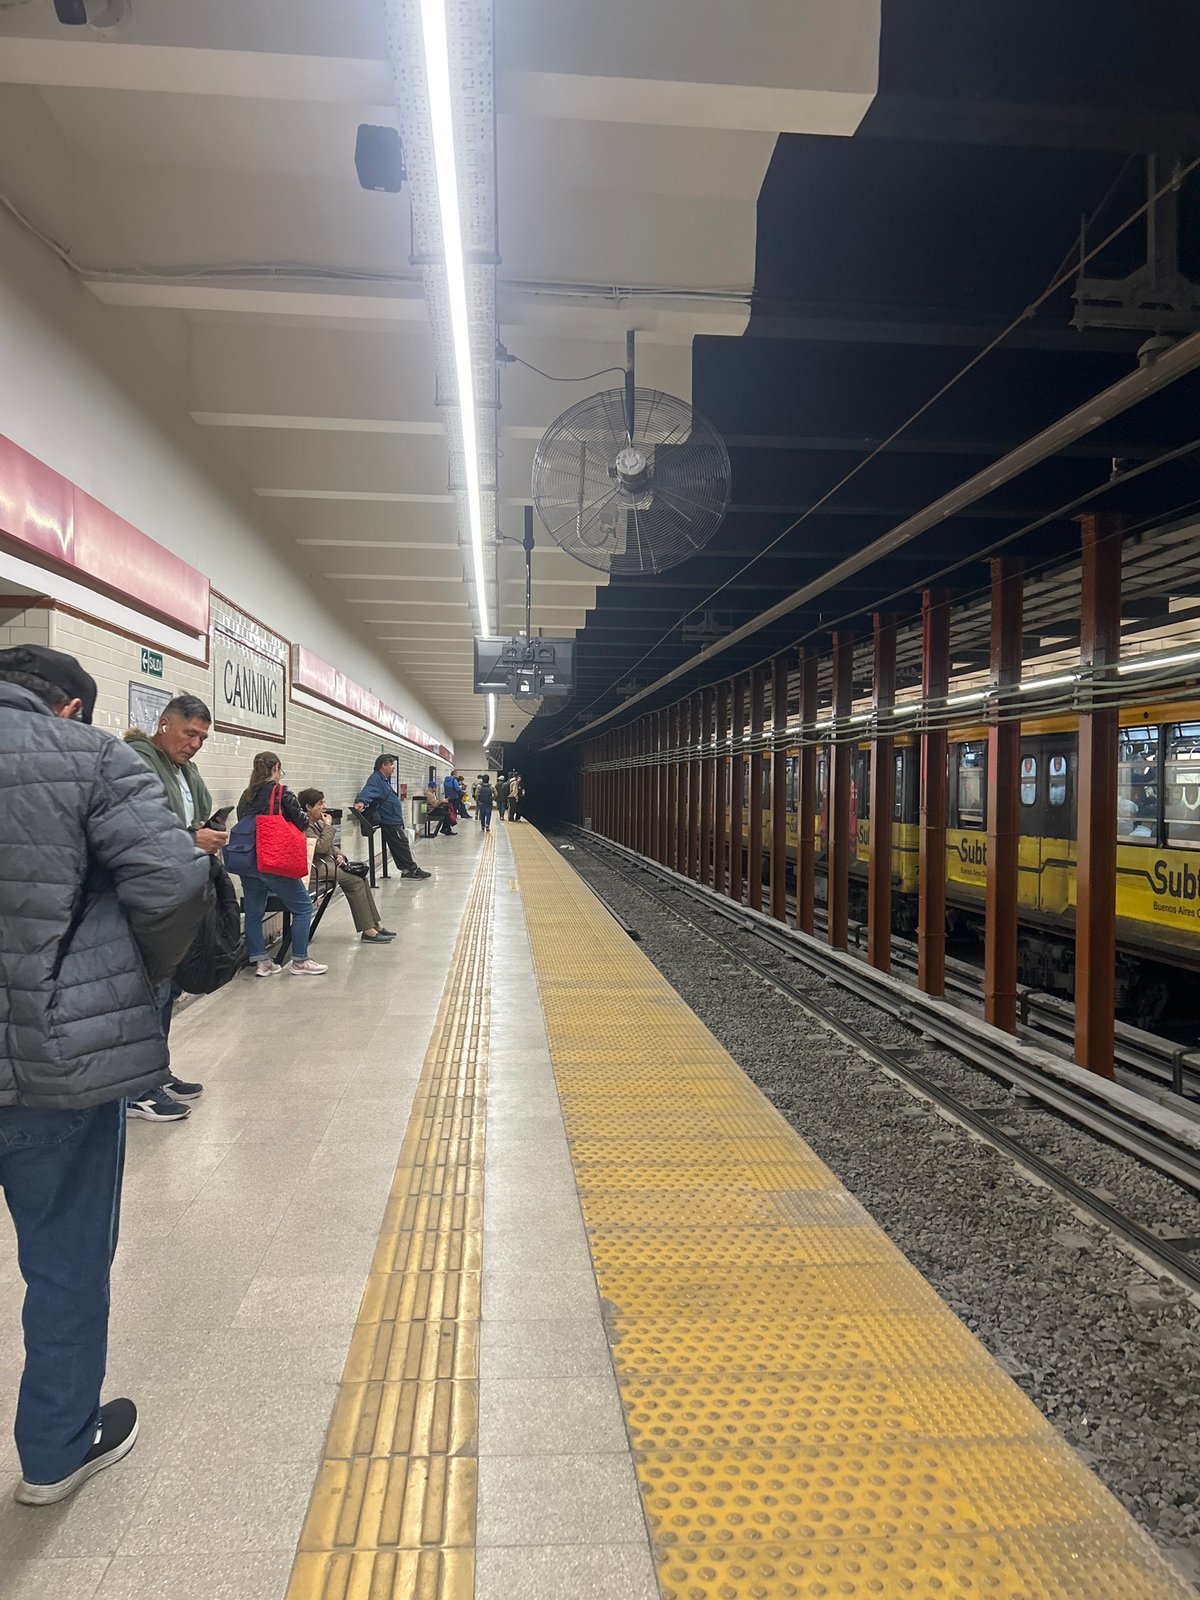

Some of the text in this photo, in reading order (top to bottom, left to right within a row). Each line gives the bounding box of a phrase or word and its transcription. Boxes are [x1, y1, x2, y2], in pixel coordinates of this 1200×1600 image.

[224, 659, 277, 719] CANNING
[1153, 901, 1177, 914] Buenos
[1178, 905, 1195, 918] Aires
